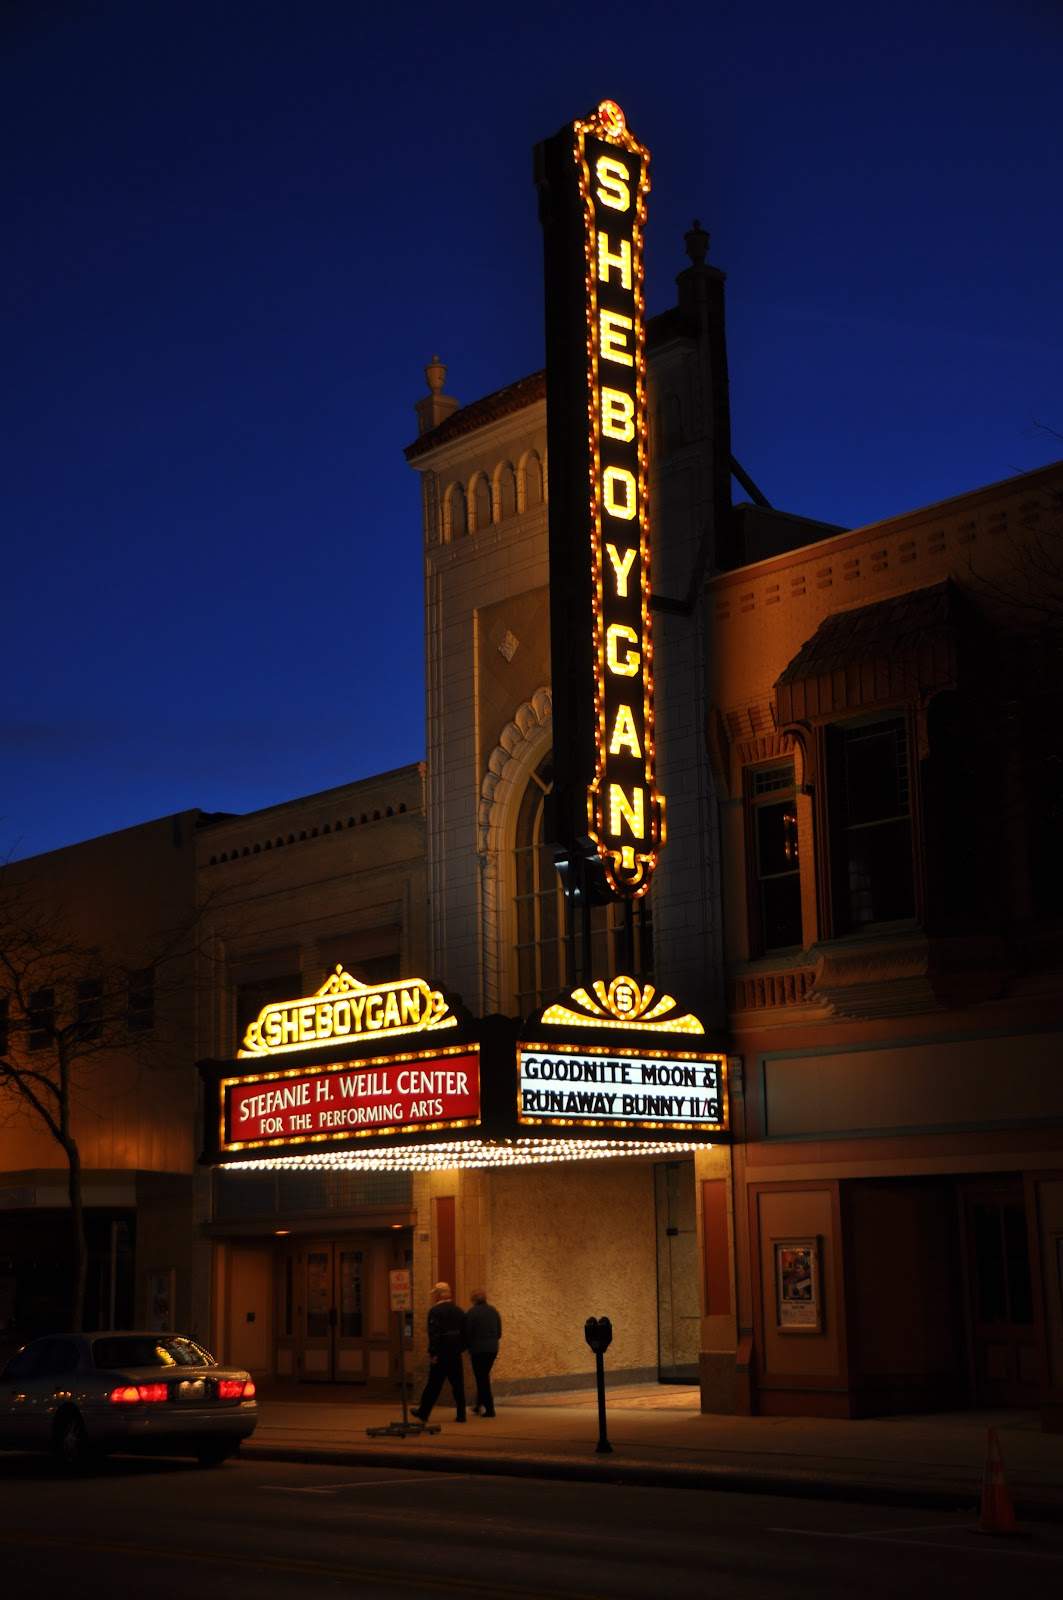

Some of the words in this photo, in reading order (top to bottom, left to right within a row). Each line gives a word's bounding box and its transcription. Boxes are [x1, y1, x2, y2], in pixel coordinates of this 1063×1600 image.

[596, 155, 644, 840] SHEBOYGAN
[265, 987, 421, 1045] SHEBOYGAN
[616, 985, 633, 1012] S
[525, 1058, 632, 1084] GOODNITE
[641, 1063, 696, 1088] MOON
[702, 1067, 716, 1088] &
[240, 1083, 310, 1121] STEFANIE
[316, 1079, 334, 1102] H.
[339, 1073, 392, 1098] WEILL
[396, 1071, 470, 1096] CENTER
[522, 1089, 617, 1115] RUNAWAY
[622, 1094, 686, 1117] BUNNY
[260, 1117, 284, 1134] FOR
[290, 1113, 312, 1130] THE
[319, 1103, 403, 1128] PERFORMING
[409, 1099, 443, 1117] ARTS
